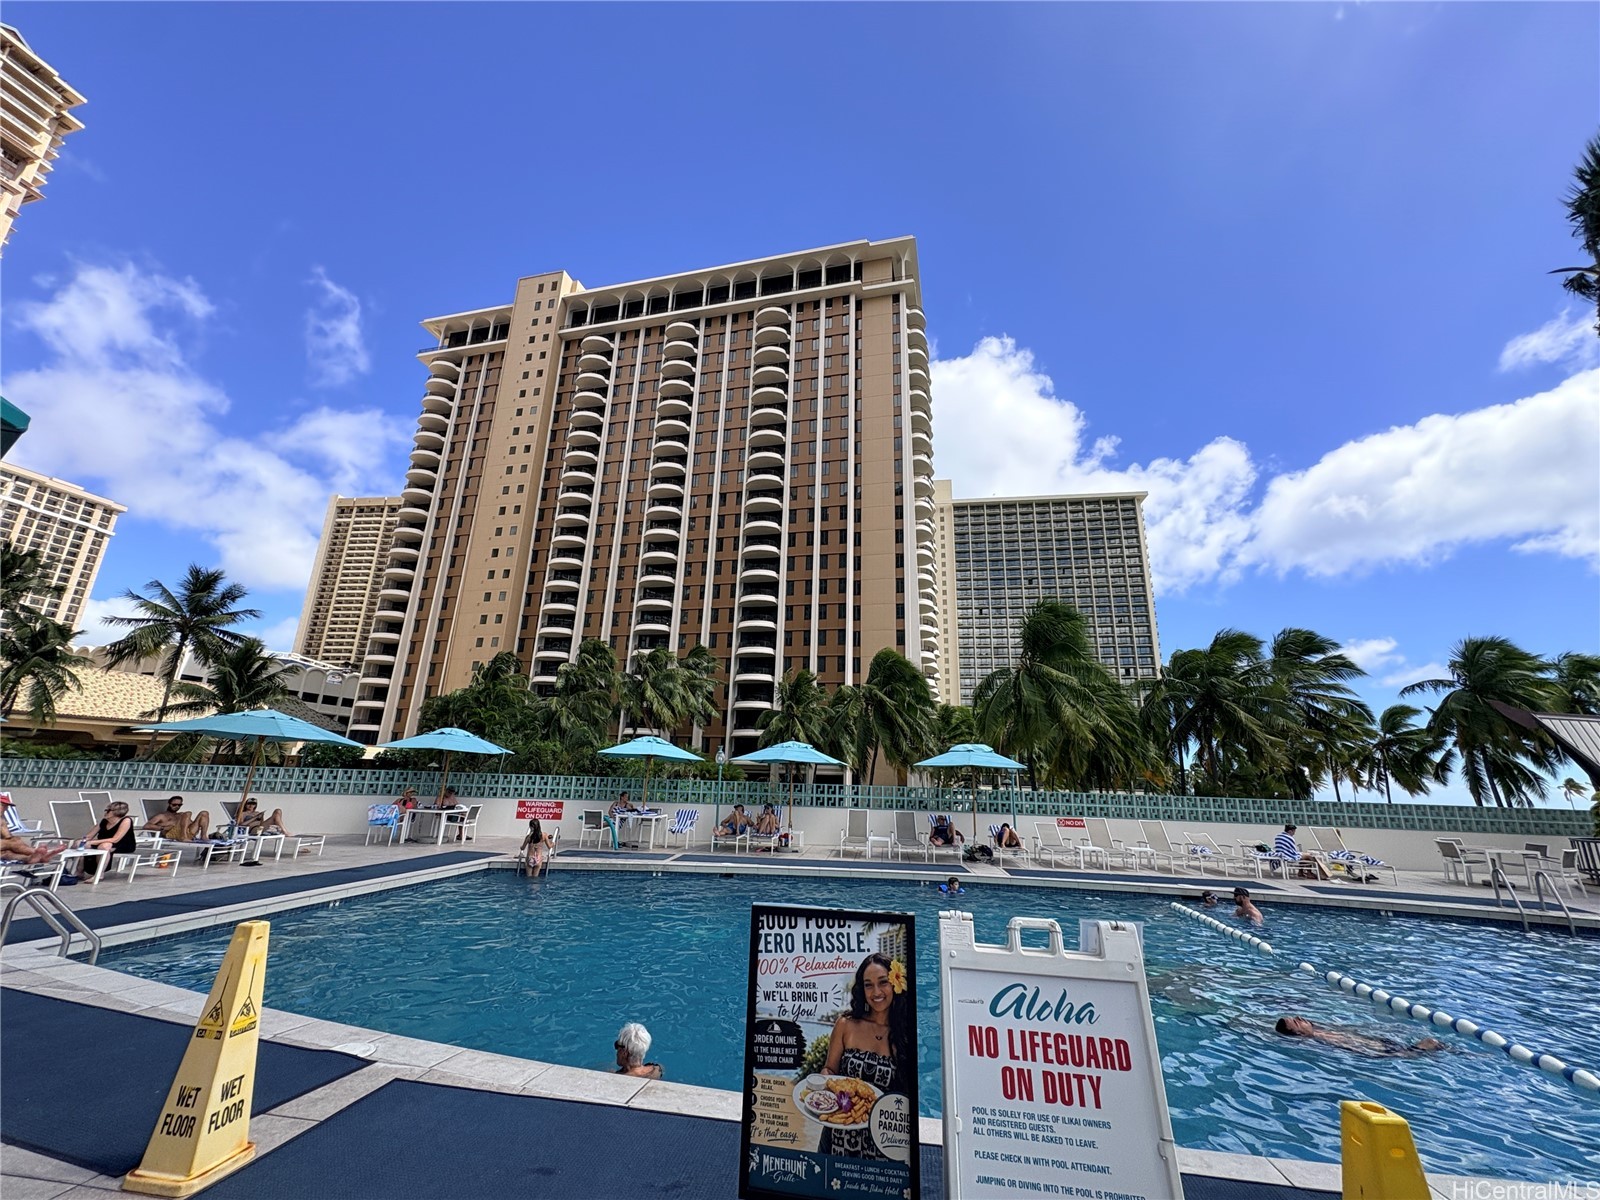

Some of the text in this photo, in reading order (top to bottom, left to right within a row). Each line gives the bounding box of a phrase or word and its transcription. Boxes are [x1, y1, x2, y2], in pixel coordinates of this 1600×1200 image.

[803, 932, 870, 953] HASSLE.
[792, 956, 858, 974] Relaxation.
[763, 991, 828, 1002] WE'LL BRING IT
[989, 983, 1100, 1025] Aloha
[778, 1004, 818, 1022] to You!
[754, 1034, 797, 1045] ORDER ONLINE
[968, 1024, 1132, 1072] NO LIFEGUARD
[176, 1085, 201, 1108] WET
[221, 1074, 245, 1102] WET
[1001, 1066, 1102, 1109] ON DUTY
[160, 1113, 196, 1138] FLOOR
[208, 1099, 244, 1134] FLOOR
[972, 1106, 1111, 1129] POOL IS SOLELY FOR USE OF ILIKAI OWNERS
[972, 1117, 1056, 1134] AND REGISTERED GUESTS.
[764, 1127, 780, 1138] that
[780, 1131, 799, 1144] easy.
[973, 1127, 1098, 1149] ALL OTHERS WILL BE ASKED TO LEAVE.
[762, 1154, 807, 1179] MENEHUNE
[834, 1162, 860, 1171] BREAKFAST
[884, 1169, 909, 1177] COCKTAILS
[974, 1150, 1112, 1175] PLEASE CHECK IN WITH POOL ATTENDANT.
[773, 1171, 795, 1183] Grille
[976, 1175, 1005, 1186] JUMPING
[1007, 1179, 1017, 1188] OR
[1019, 1180, 1041, 1191] DIVING
[1043, 1184, 1059, 1193] INTO
[1060, 1186, 1074, 1196] THE
[1076, 1188, 1094, 1198] POOL
[1095, 1190, 1102, 1199] IS
